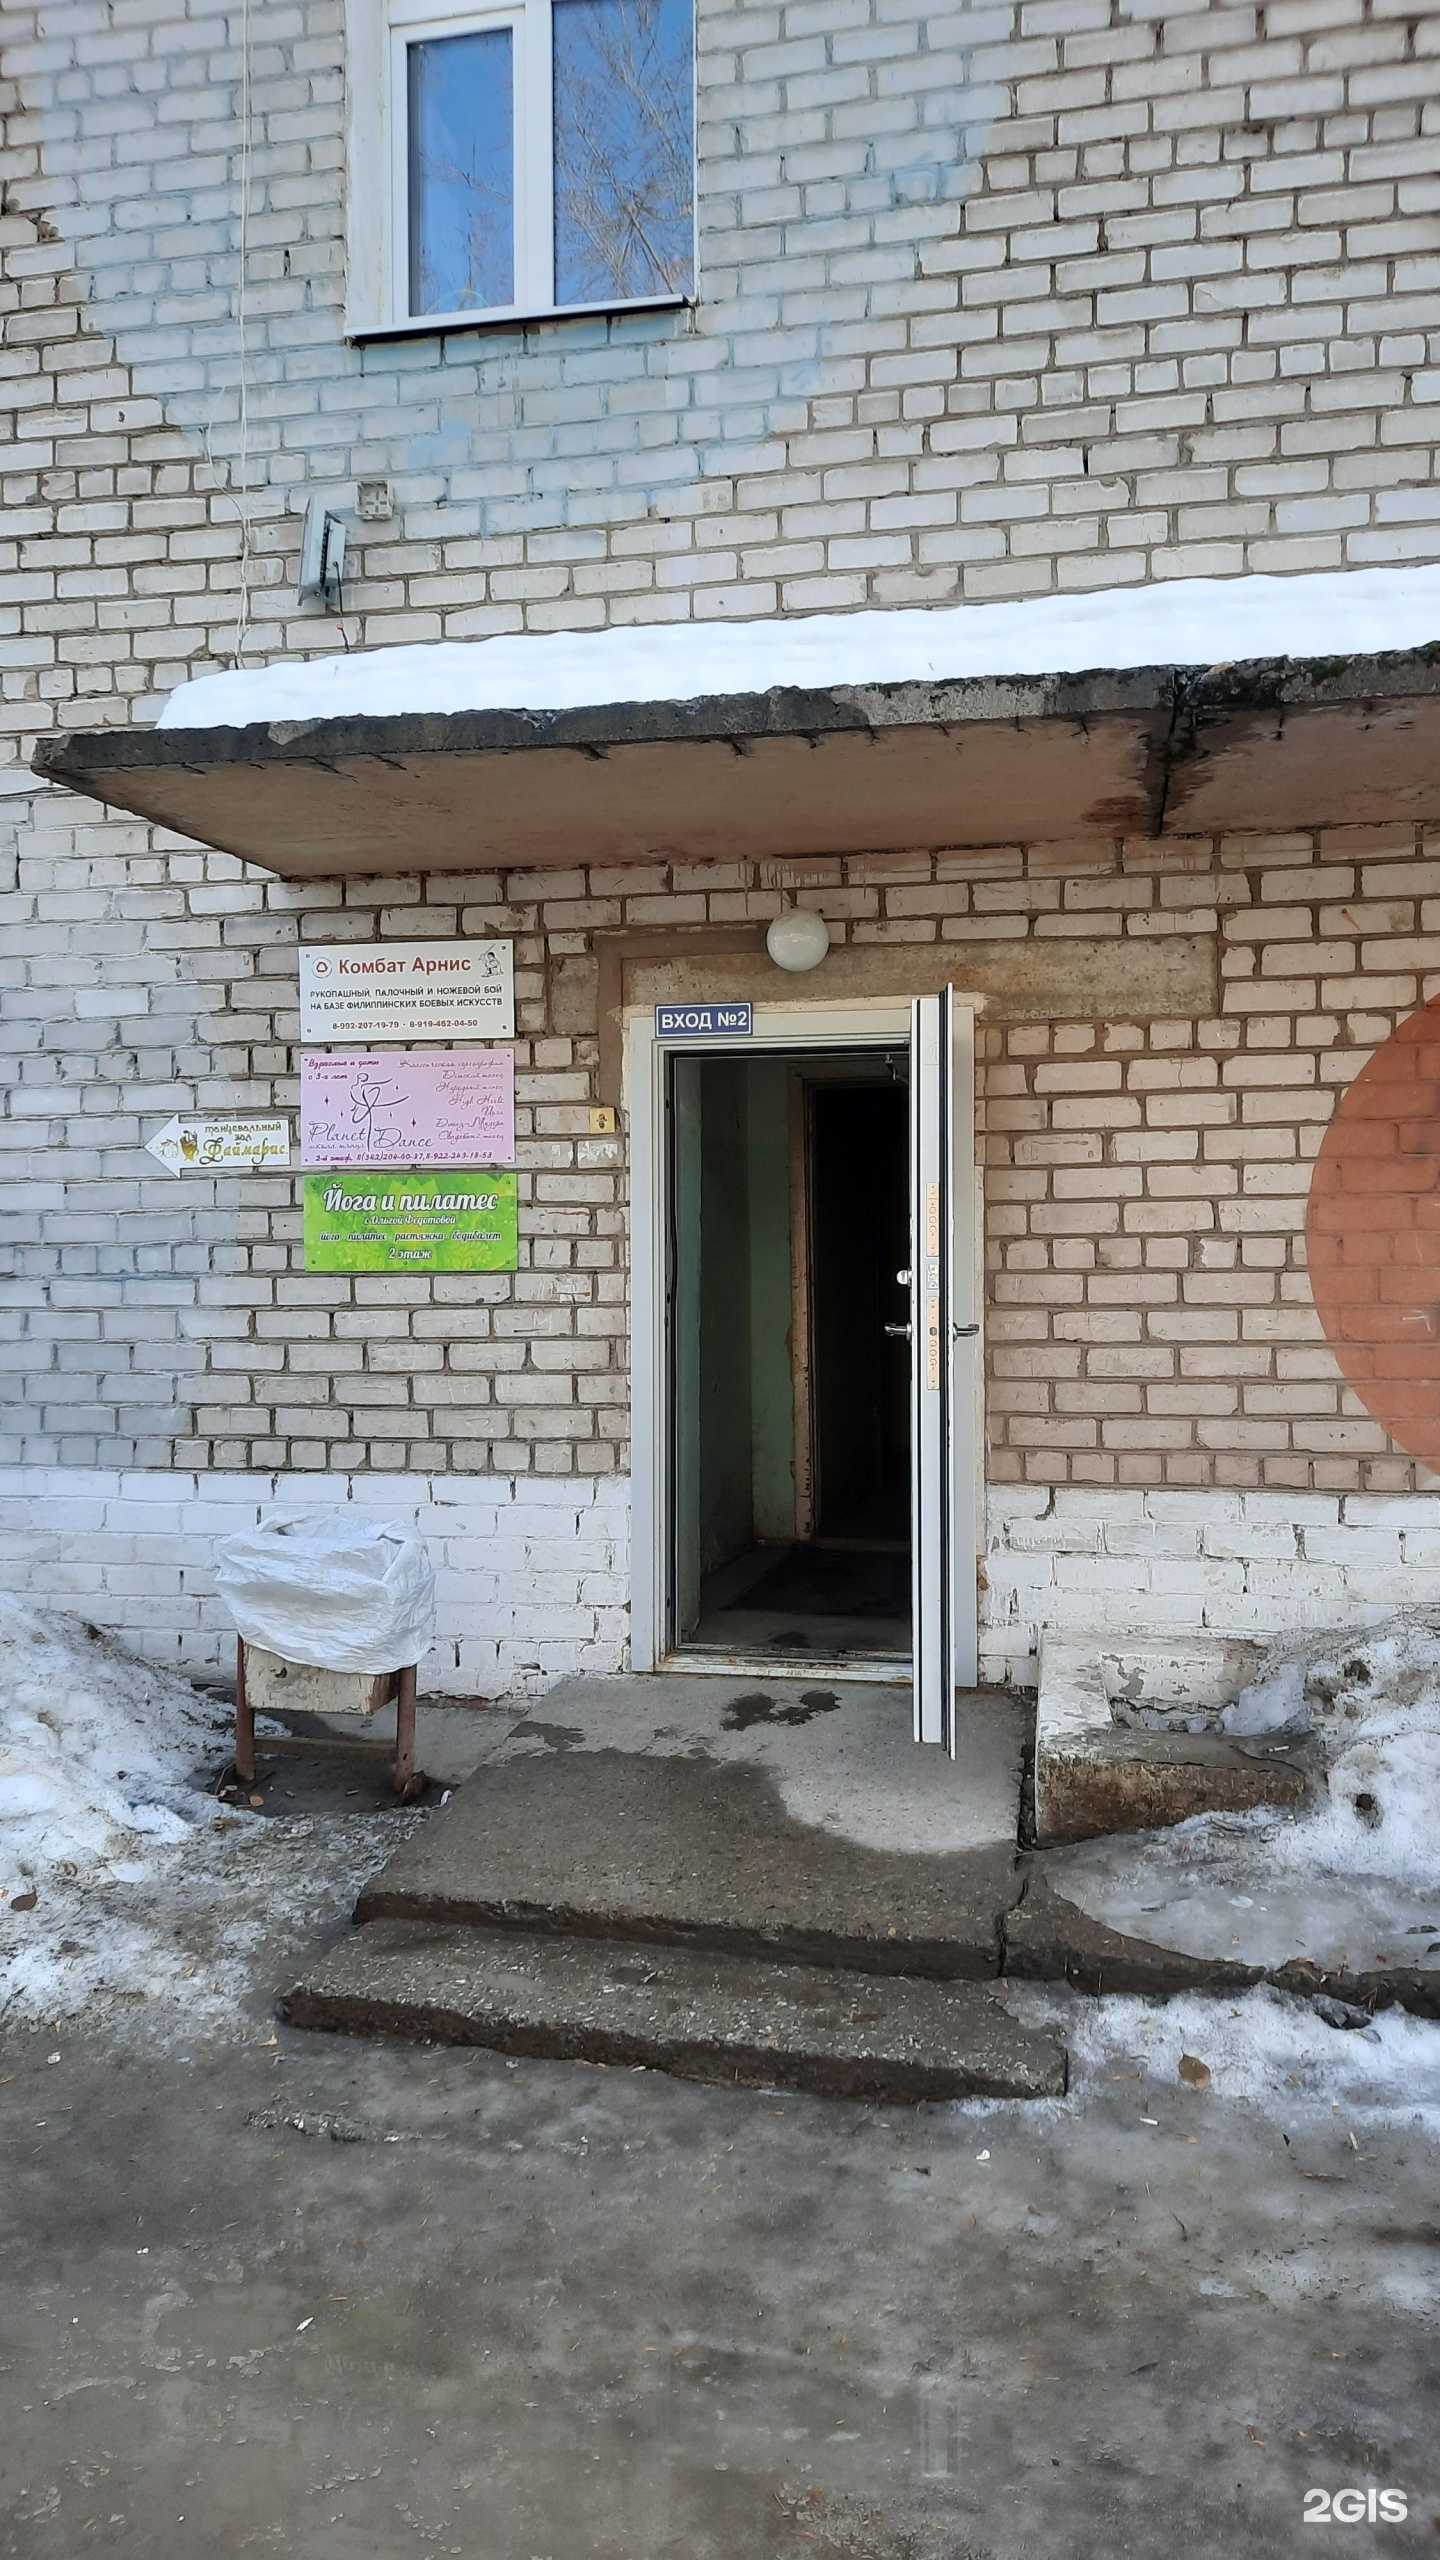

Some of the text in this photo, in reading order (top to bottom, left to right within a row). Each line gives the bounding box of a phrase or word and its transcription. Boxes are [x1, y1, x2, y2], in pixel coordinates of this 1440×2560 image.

[338, 956, 472, 976] Комбат Арнис
[375, 986, 424, 997] ПАЛОЧНЫЙ
[427, 986, 433, 995] И
[437, 984, 480, 995] НОЖЕВОЙ
[484, 983, 502, 994] БОЙ
[324, 1002, 345, 1010] БАЗЕ
[346, 1000, 417, 1009] ФИЛИППИНСКИХ
[419, 999, 455, 1008] БОЕВЫХ
[457, 998, 503, 1007] ИСКУССТВ
[661, 1011, 747, 1030] ВХОД №2
[308, 1121, 366, 1142] Planet
[373, 1127, 433, 1149] Dance
[323, 1183, 498, 1212] Йога и пилатес
[389, 1247, 433, 1260] 2 этаж
